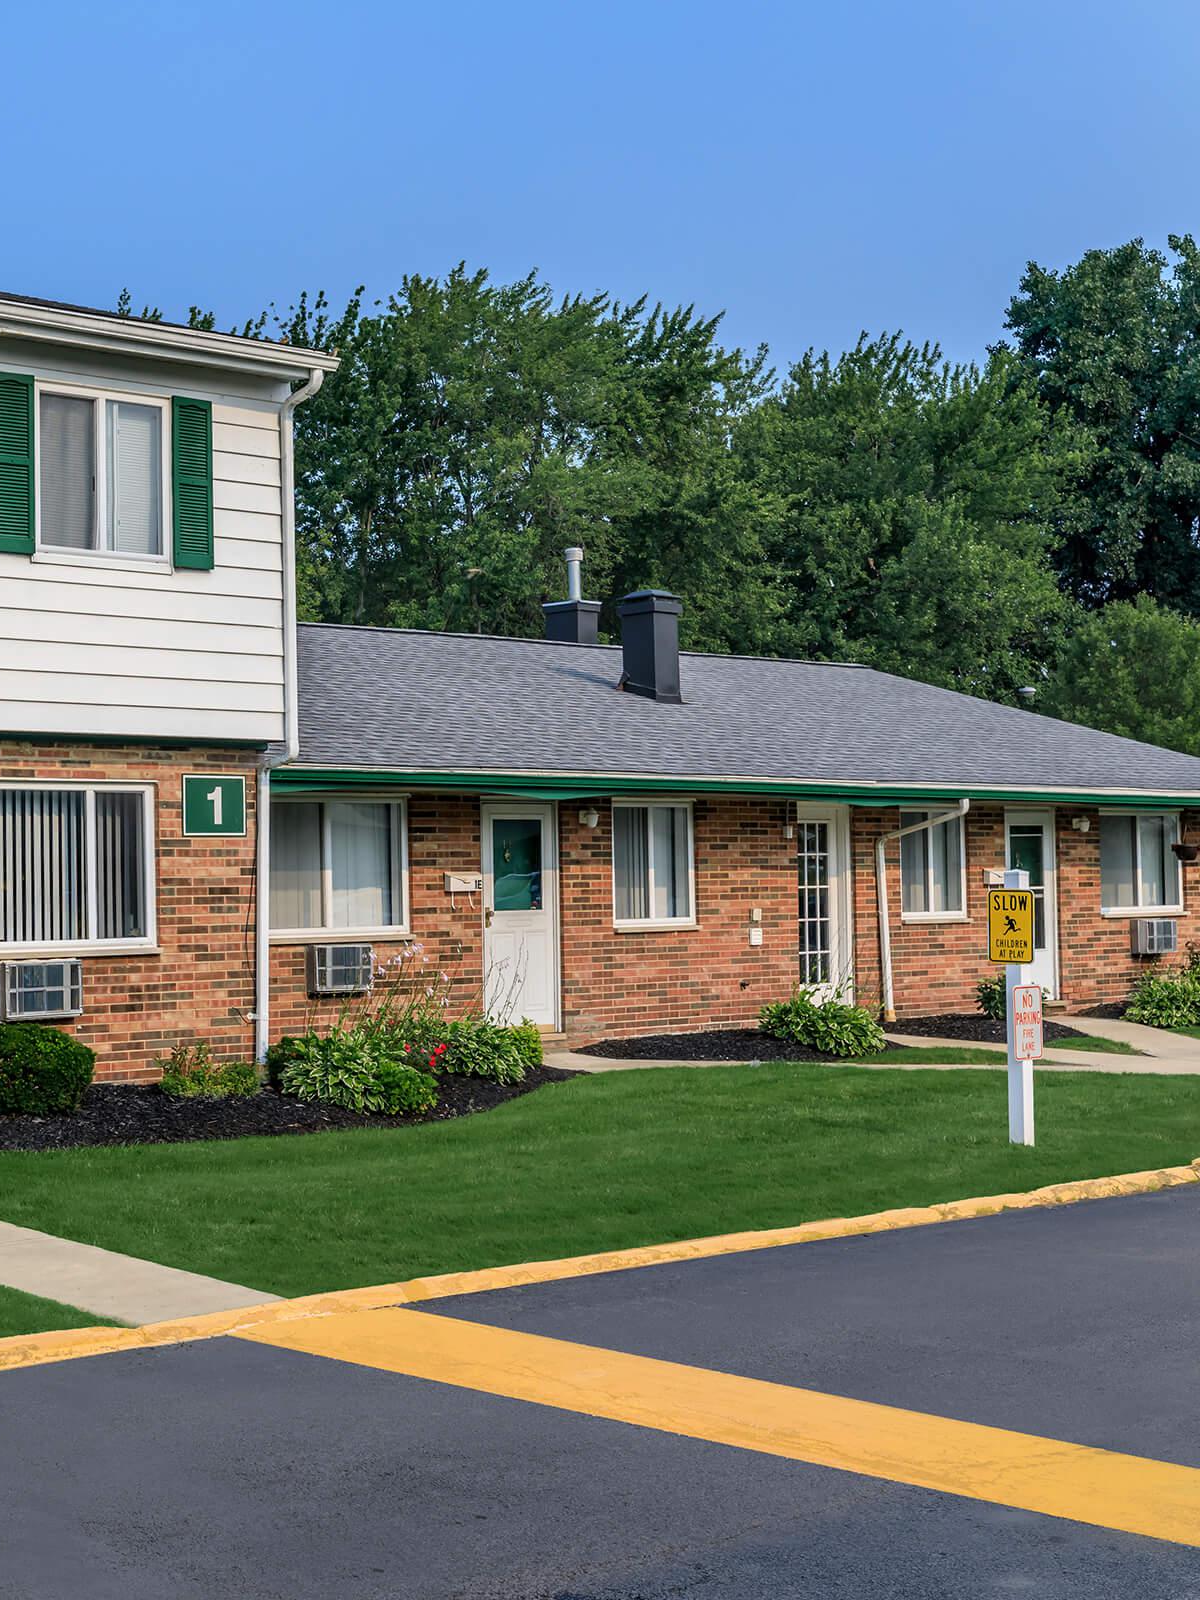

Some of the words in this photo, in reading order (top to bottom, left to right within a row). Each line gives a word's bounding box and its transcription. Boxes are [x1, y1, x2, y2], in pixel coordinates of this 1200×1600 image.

[207, 786, 222, 825] 1
[993, 895, 1027, 911] SLOW
[995, 939, 1028, 948] CHILDREN
[999, 949, 1006, 958] AT
[1008, 950, 1025, 959] PLAY
[1022, 993, 1033, 1008] NO
[1016, 1011, 1041, 1024] PARKING
[1022, 1042, 1035, 1052] LANE
